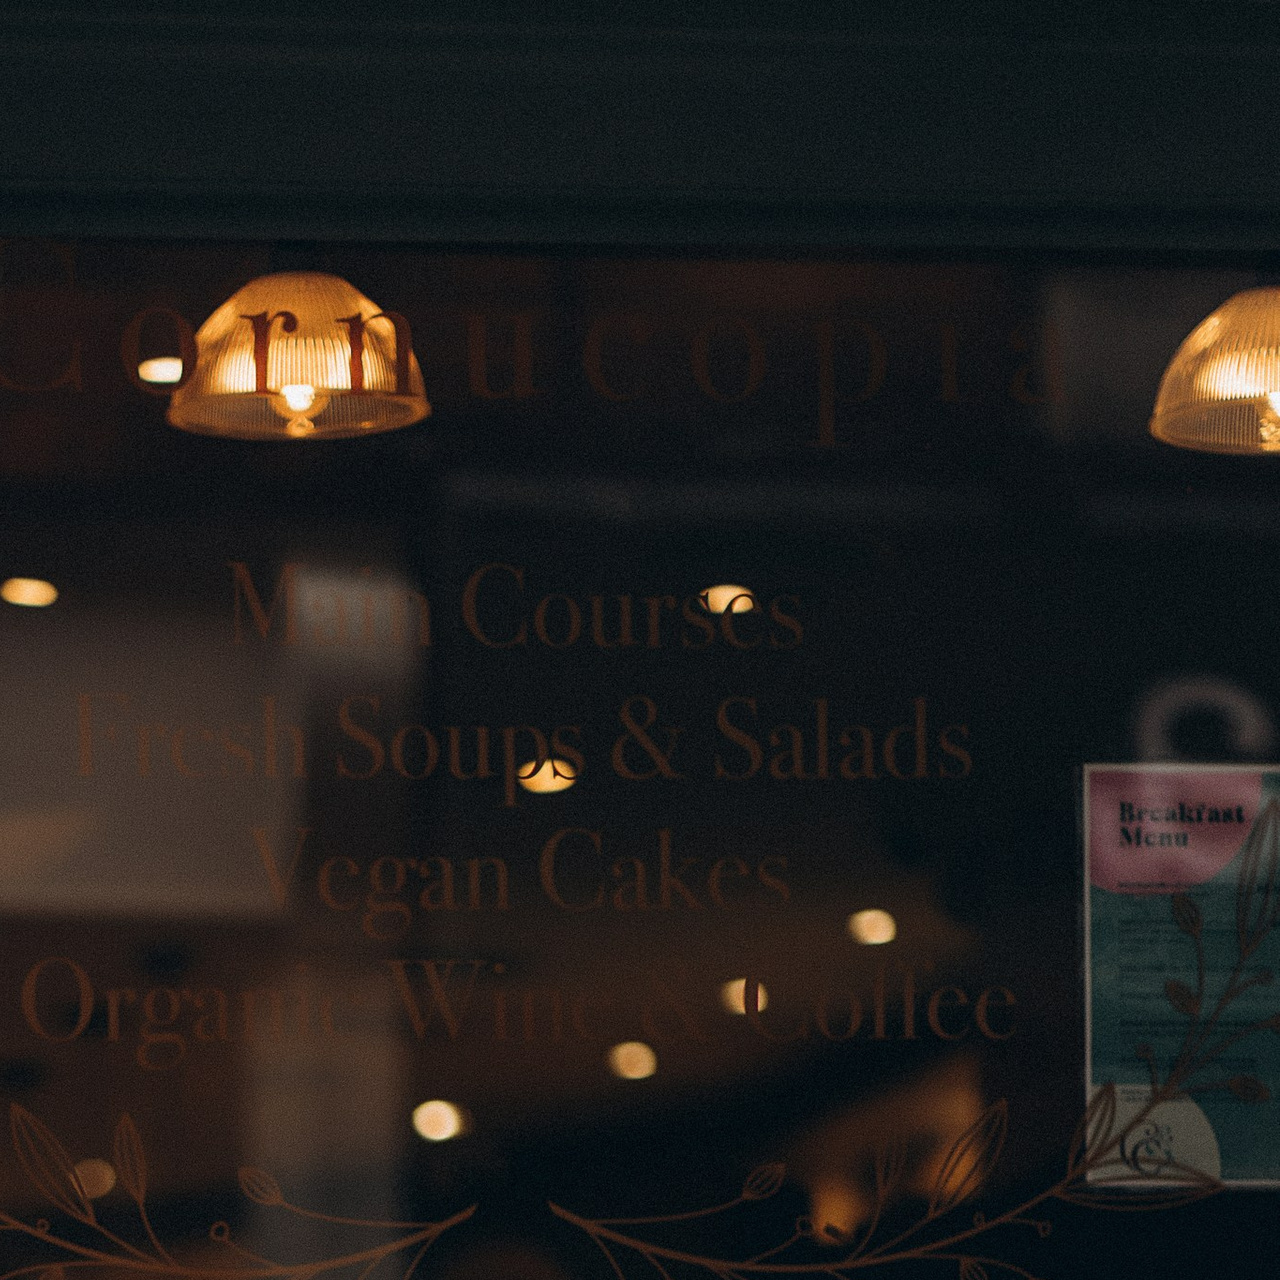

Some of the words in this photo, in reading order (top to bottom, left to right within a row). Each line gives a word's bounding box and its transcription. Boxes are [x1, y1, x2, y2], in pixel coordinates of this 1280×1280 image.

[225, 561, 433, 647] Main
[460, 561, 806, 649] Courses
[74, 693, 310, 778] Fresh
[335, 694, 585, 807] Soups
[609, 694, 686, 781] &
[713, 694, 974, 781] Salads
[1119, 802, 1246, 824] Breakfast
[1120, 826, 1189, 848] Menu
[250, 826, 512, 941] Vegan
[538, 826, 793, 911] Cakes
